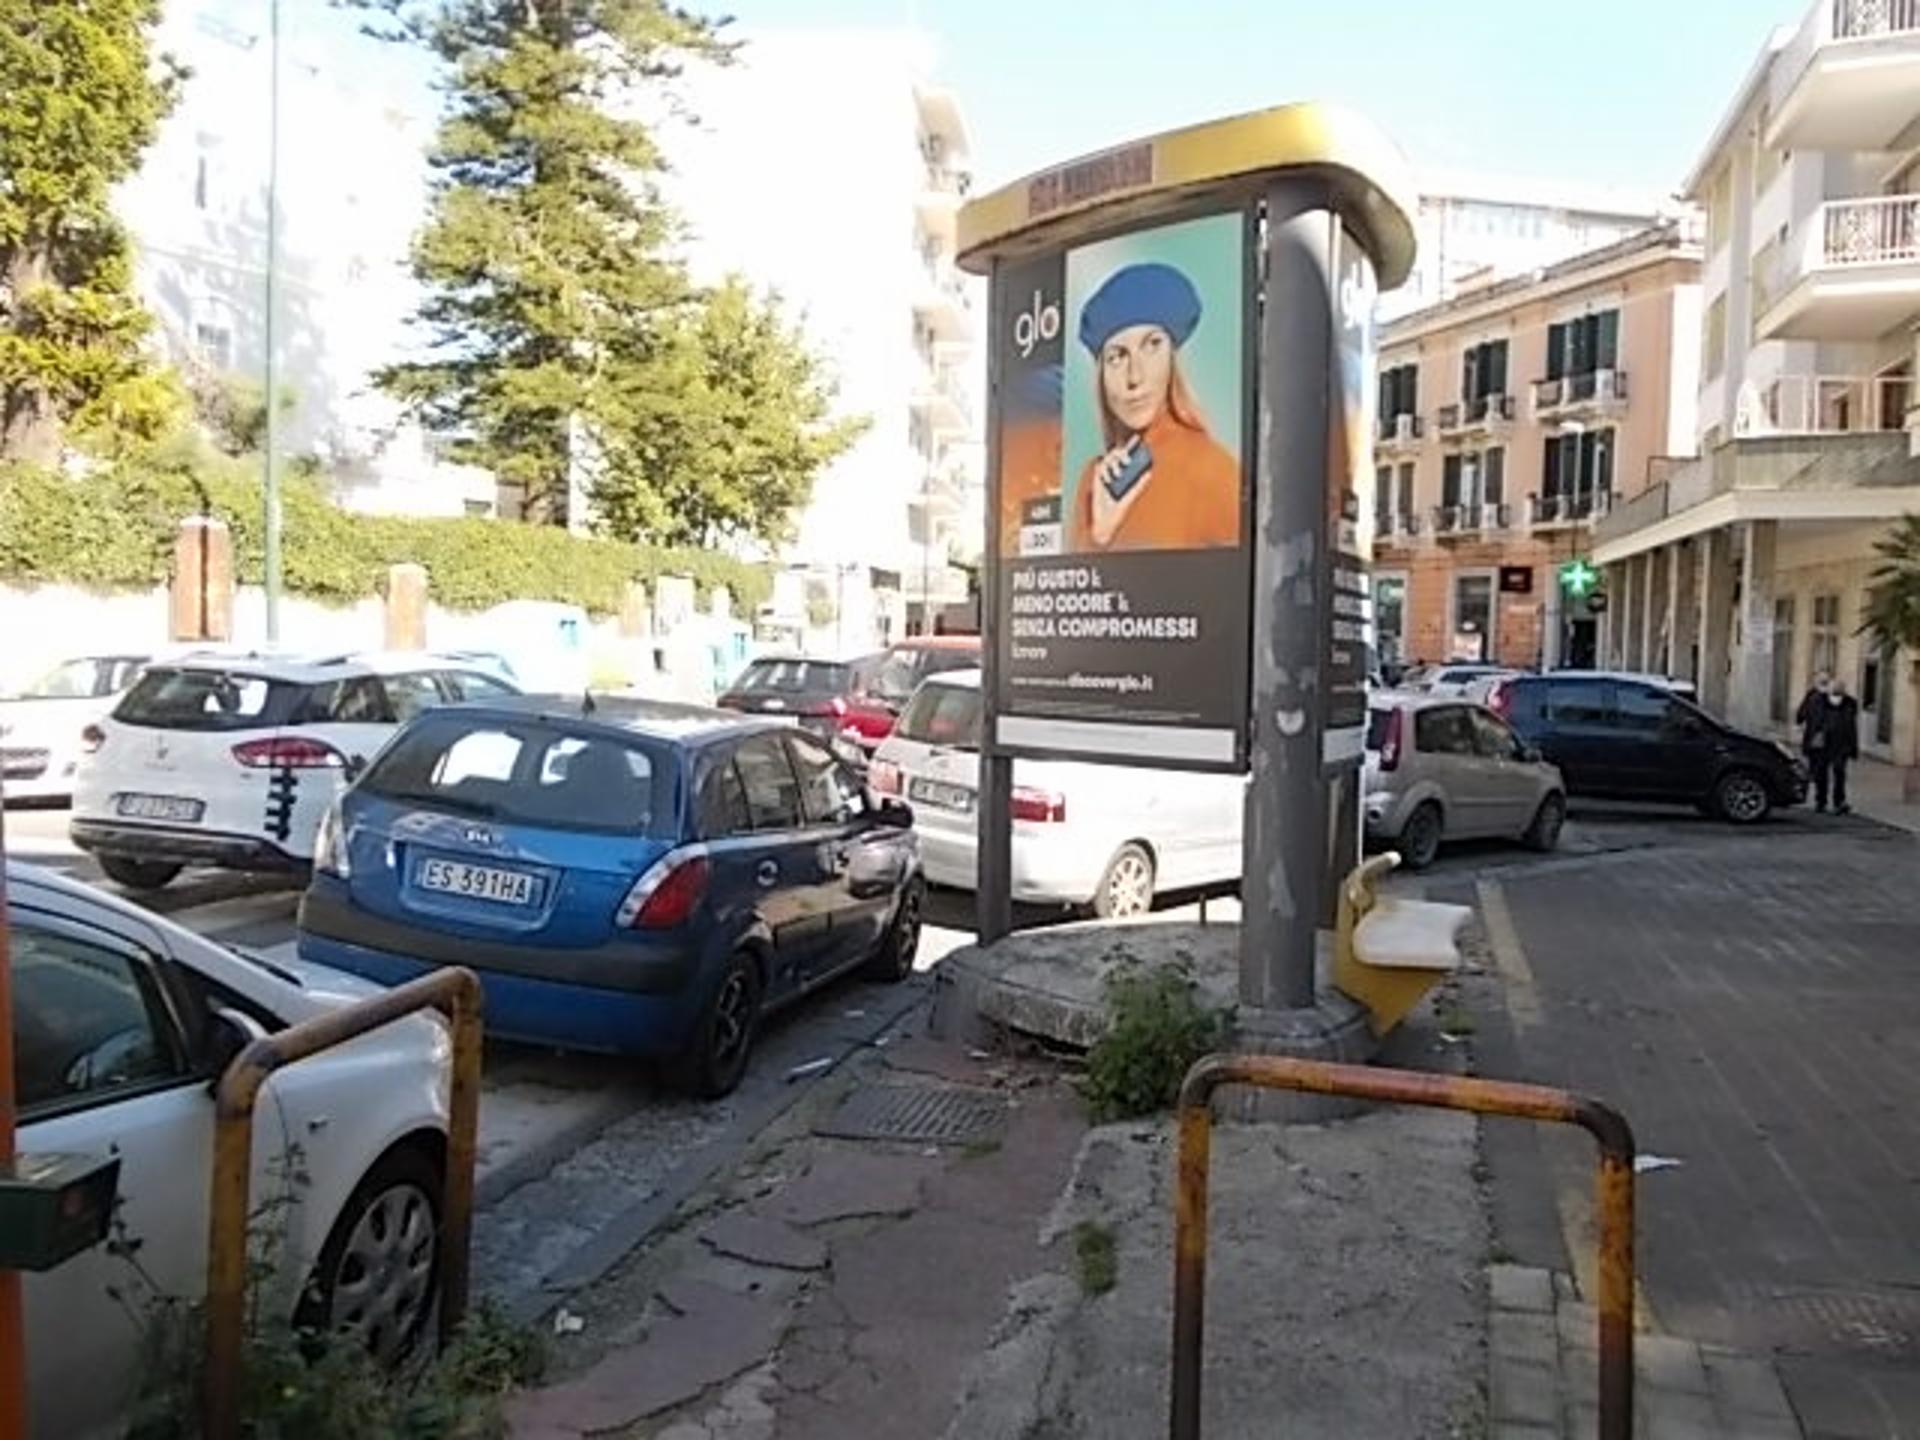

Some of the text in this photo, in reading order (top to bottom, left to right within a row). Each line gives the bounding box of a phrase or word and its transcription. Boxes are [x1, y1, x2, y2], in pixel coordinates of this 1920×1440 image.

[1015, 290, 1060, 358] glo
[1038, 568, 1089, 590] GUSTO
[1012, 594, 1054, 613] MENO
[1012, 617, 1198, 638] SENZA COMPROMESSI
[427, 862, 454, 888] ES
